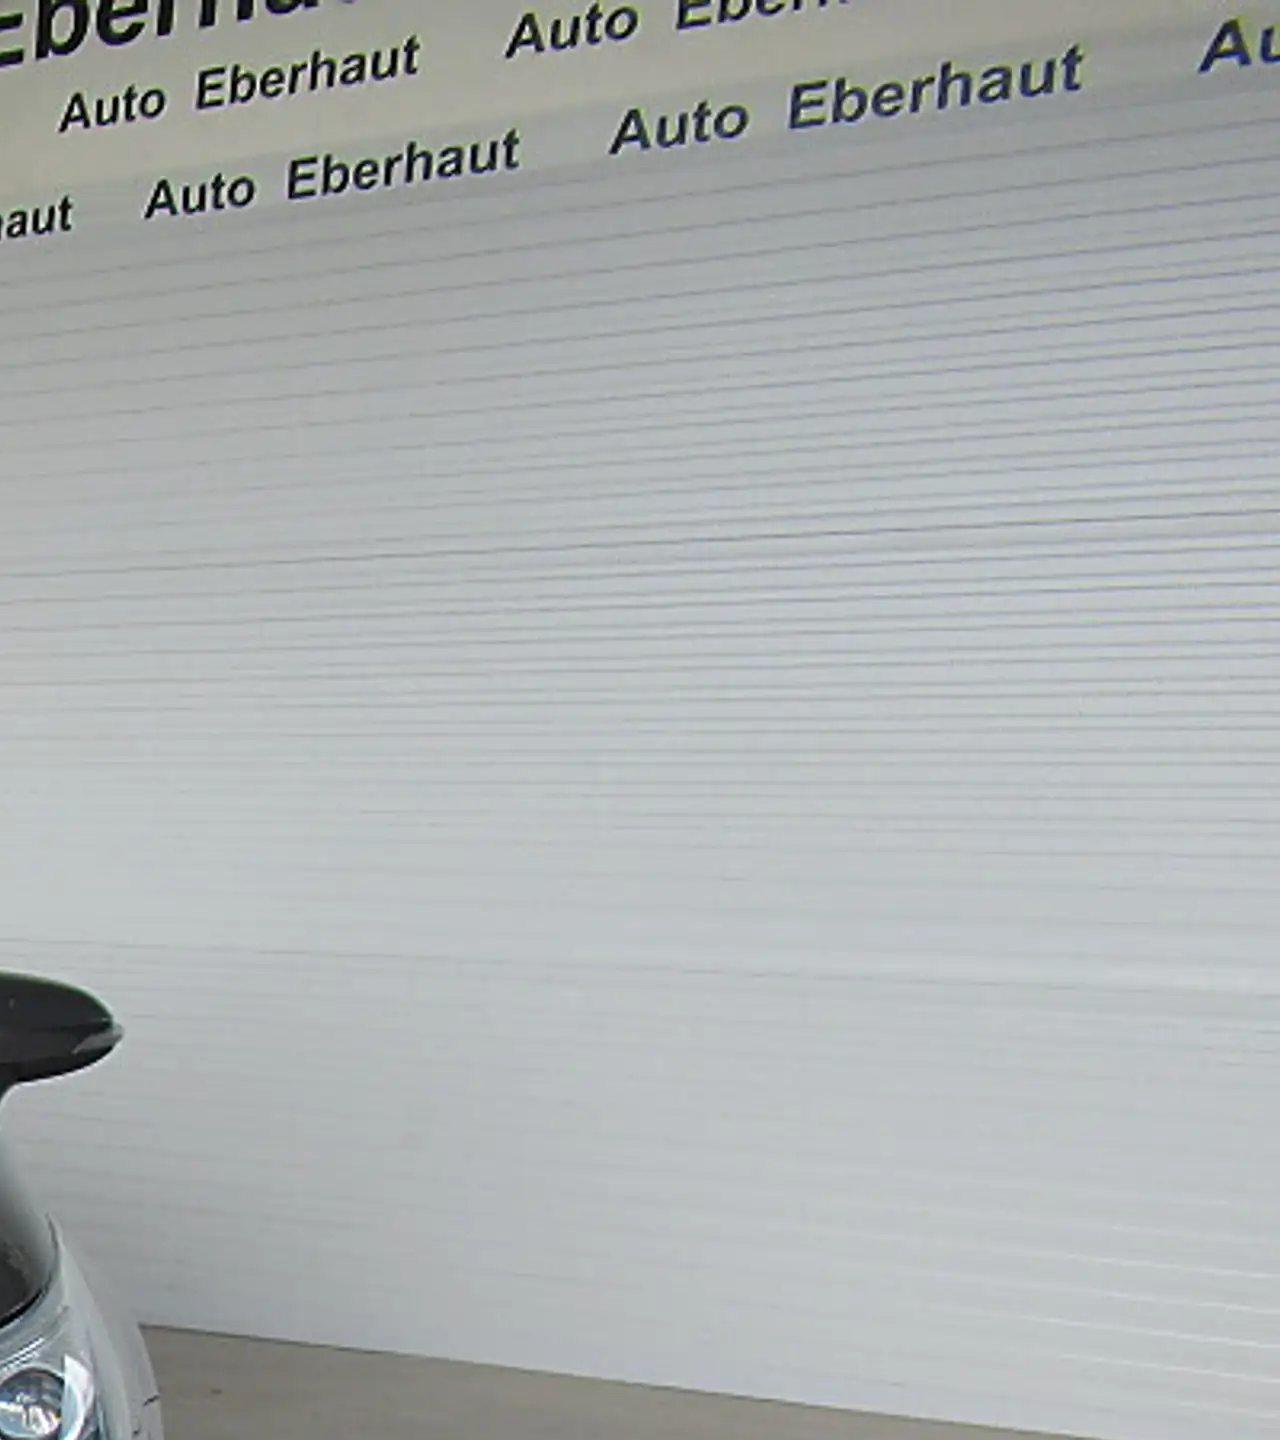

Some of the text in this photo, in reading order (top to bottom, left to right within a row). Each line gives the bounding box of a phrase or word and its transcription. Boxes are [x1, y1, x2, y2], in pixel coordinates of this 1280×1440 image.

[504, 2, 639, 59] Auto
[57, 34, 421, 134] Auto Eberhaut
[607, 43, 1085, 156] Auto Eberhaut
[143, 127, 521, 221] Auto Eberhaut
